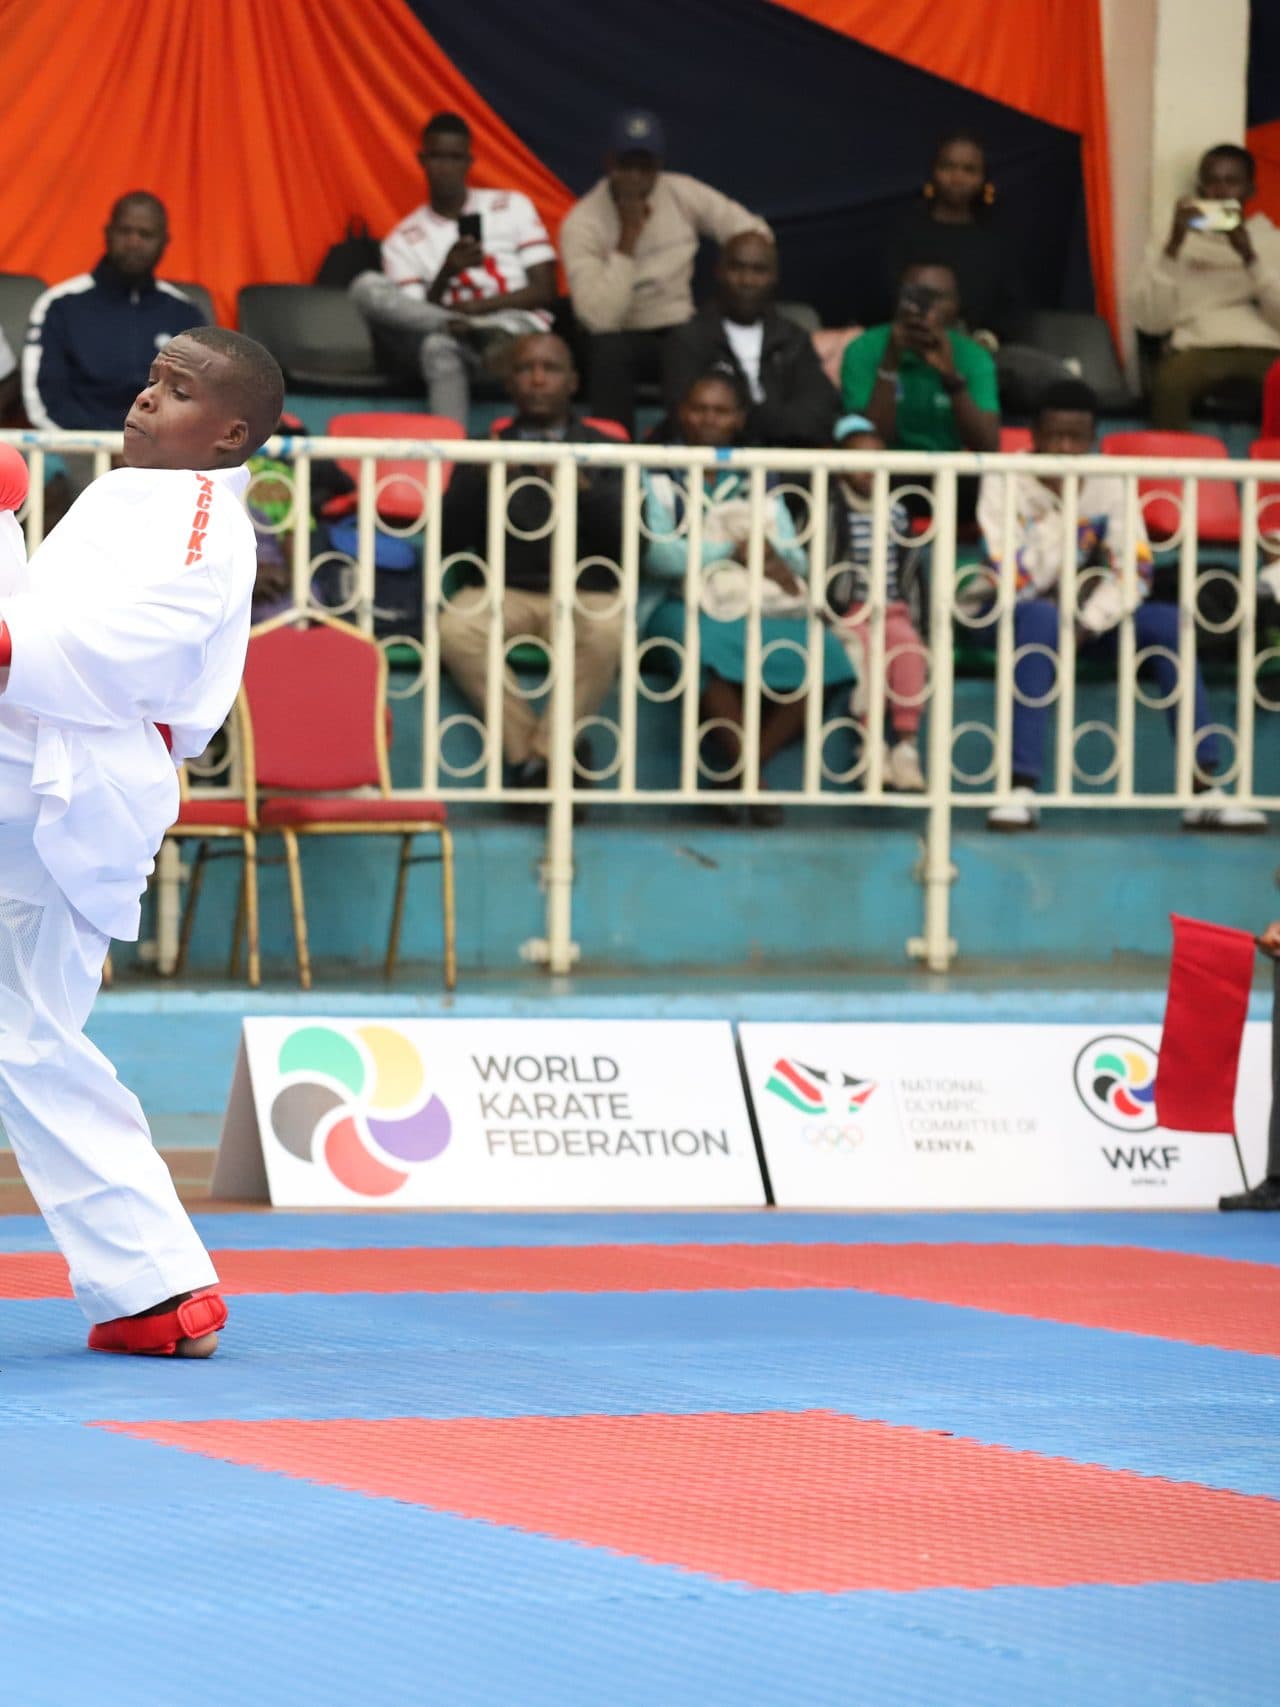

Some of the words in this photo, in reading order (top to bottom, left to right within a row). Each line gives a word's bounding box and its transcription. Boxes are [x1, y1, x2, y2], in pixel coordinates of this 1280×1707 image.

[471, 1054, 620, 1083] WORLD
[900, 1078, 986, 1093] NATIONAL
[478, 1092, 633, 1120] KARATE
[904, 1098, 979, 1113] OLYMPIC
[909, 1117, 1011, 1133] COMMITTEE
[1016, 1117, 1038, 1133] OF
[485, 1129, 730, 1156] FEDERATION
[913, 1138, 976, 1152] KENYA
[1101, 1145, 1181, 1171] WKF
